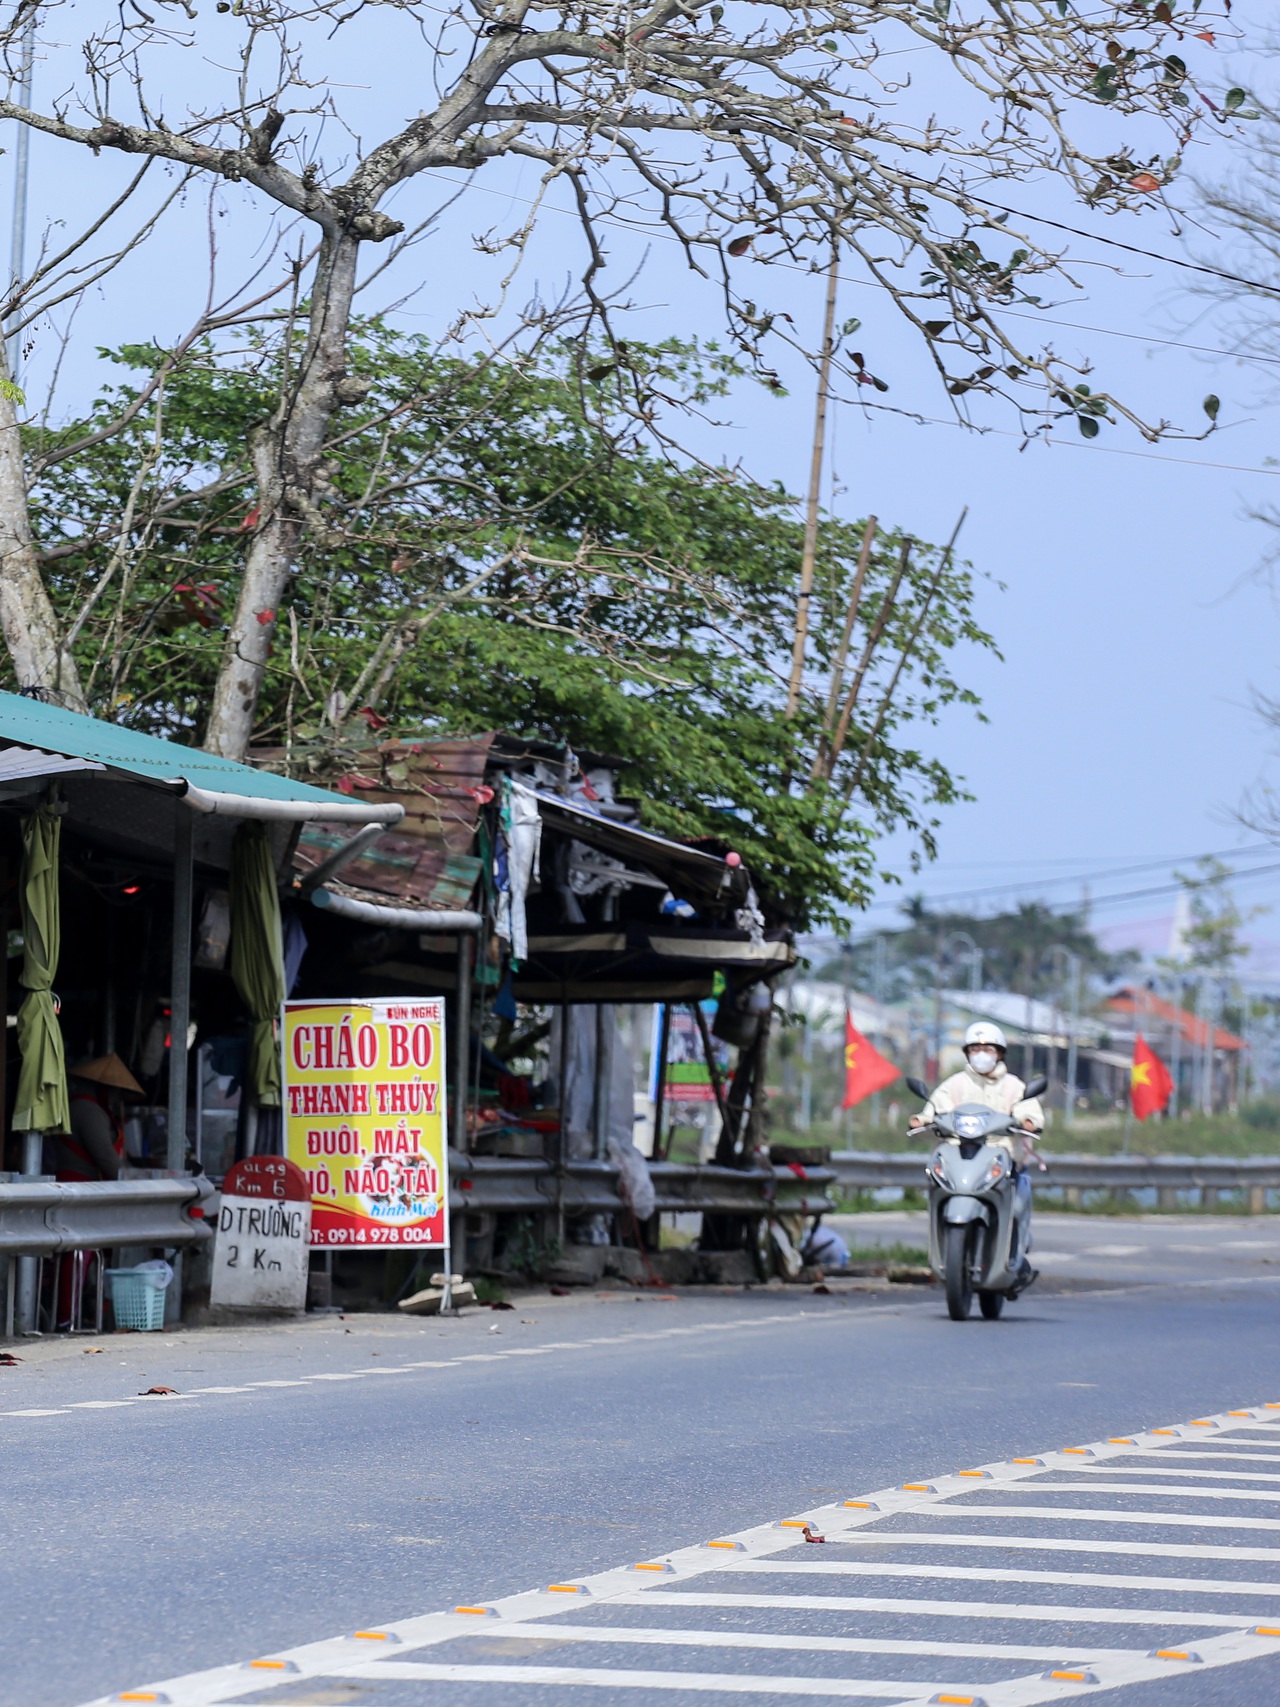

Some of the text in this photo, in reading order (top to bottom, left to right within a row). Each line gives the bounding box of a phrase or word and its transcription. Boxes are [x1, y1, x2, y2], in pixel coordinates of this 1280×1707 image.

[293, 1015, 378, 1070] CHÁO
[288, 1084, 368, 1114] THANH
[308, 1119, 422, 1157] ĐUÔI, MẮT
[235, 1175, 286, 1197] Km 6
[345, 1164, 396, 1197] NÃO,
[328, 1228, 366, 1243] 0914
[370, 1228, 399, 1243] 978
[403, 1227, 432, 1242] 004
[227, 1245, 282, 1271] 2 Km
